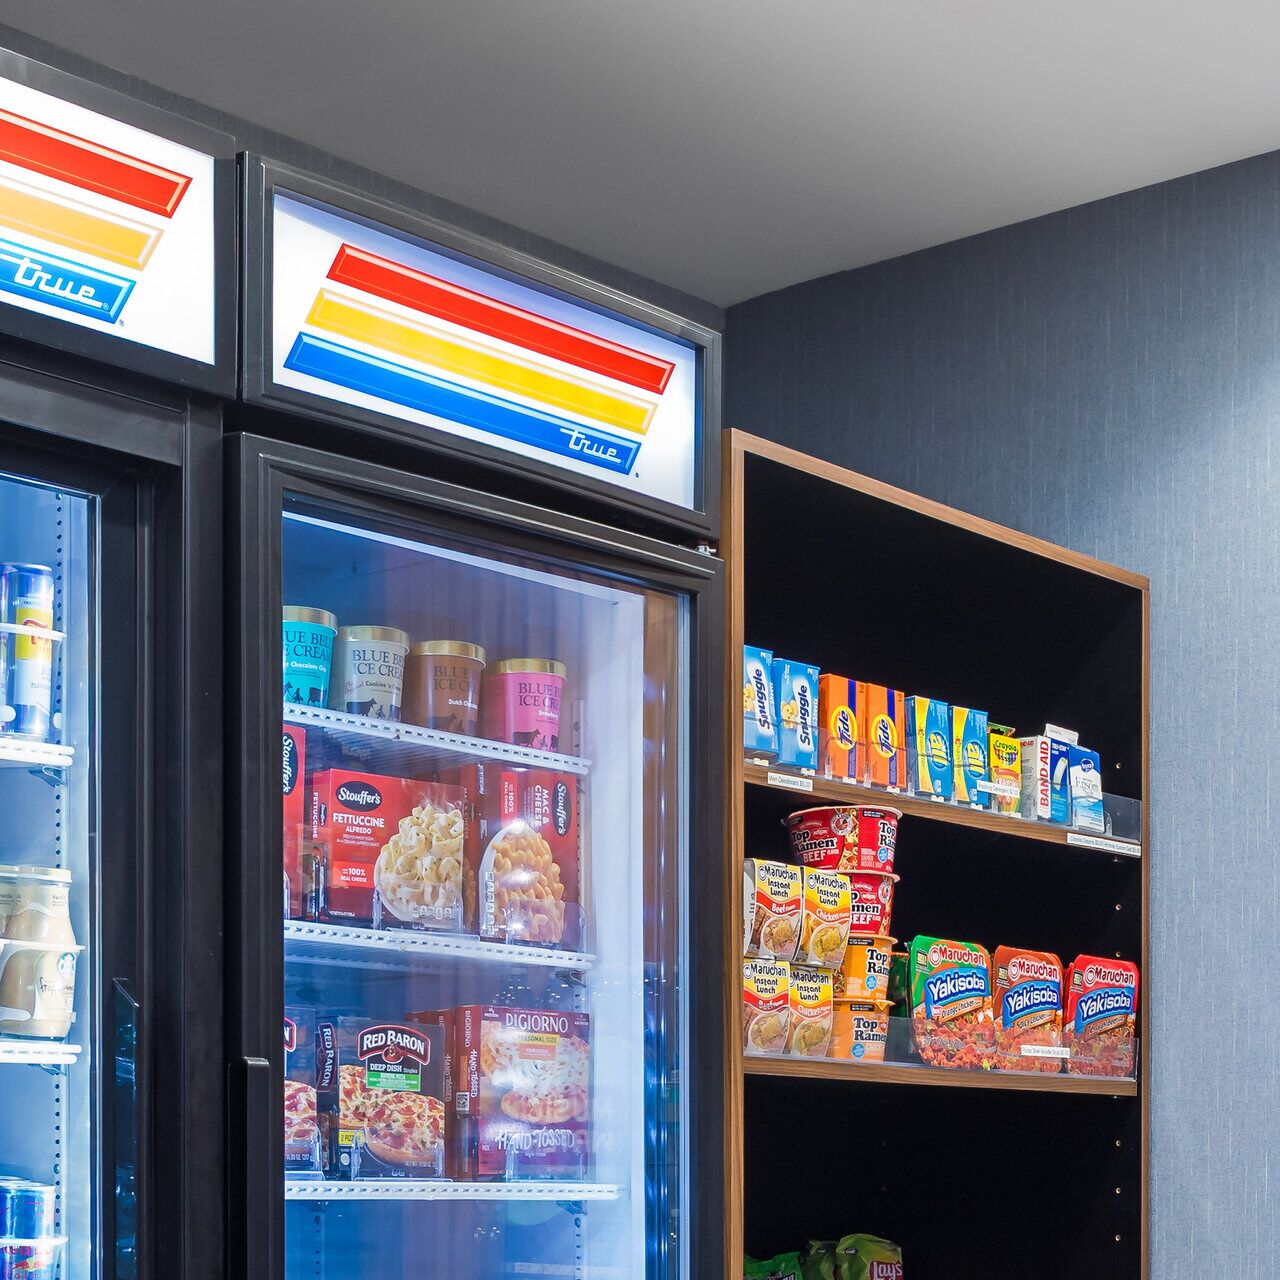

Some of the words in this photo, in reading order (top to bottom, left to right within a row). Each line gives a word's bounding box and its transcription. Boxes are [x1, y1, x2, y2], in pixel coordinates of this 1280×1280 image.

[560, 428, 622, 463] true
[352, 650, 384, 663] BLUE
[354, 663, 376, 675] ICE
[434, 666, 463, 679] BLUE
[366, 680, 386, 688] Cookies
[519, 682, 548, 695] BLUE
[448, 698, 462, 707] Dutch
[519, 695, 541, 707] ICE
[753, 668, 770, 730] Snuggle
[797, 684, 811, 746] Snuggle
[838, 710, 854, 749] Tide
[878, 718, 895, 754] Tide
[994, 739, 1017, 752] Crayola
[1040, 740, 1049, 807] BAND-AID
[337, 787, 382, 805] Stouffer's
[541, 788, 550, 808] MAC
[534, 784, 542, 828] CHEESE
[556, 783, 566, 836] Stouffer's
[332, 813, 385, 829] FETTUCCINE
[345, 825, 372, 835] ALFREDO
[792, 831, 809, 842] Top
[793, 838, 837, 853] Ramen
[803, 850, 826, 863] BEEF
[348, 868, 366, 877] 100%
[764, 865, 799, 882] Maruchan
[768, 880, 791, 891] Instant
[813, 874, 848, 891] Maruchan
[770, 889, 789, 899] Lunch
[817, 889, 841, 900] Instant
[819, 897, 839, 908] Lunch
[816, 909, 840, 922] Chicken
[867, 949, 889, 963] Top
[938, 946, 985, 965] Maruchan
[750, 964, 787, 978] Maruchan
[1019, 960, 1059, 980] Maruchan
[1095, 966, 1134, 984] Maruchan
[754, 978, 779, 988] Instant
[793, 971, 830, 986] Maruchan
[757, 986, 776, 996] Lunch
[796, 984, 822, 994] Instant
[928, 973, 986, 1001] Yakisoba
[800, 992, 819, 1002] Lunch
[1007, 986, 1058, 1013] Yakisoba
[1080, 992, 1131, 1018] Yakisoba
[853, 1017, 878, 1031] Top
[322, 1027, 333, 1047] RED
[362, 1031, 387, 1052] RED
[387, 1029, 425, 1056] BARON
[853, 1028, 887, 1043] Ramen
[320, 1048, 334, 1088] BARON
[370, 1063, 387, 1073] DEEP
[387, 1064, 402, 1074] DISH
[470, 1048, 478, 1098] HAND-TOSSED
